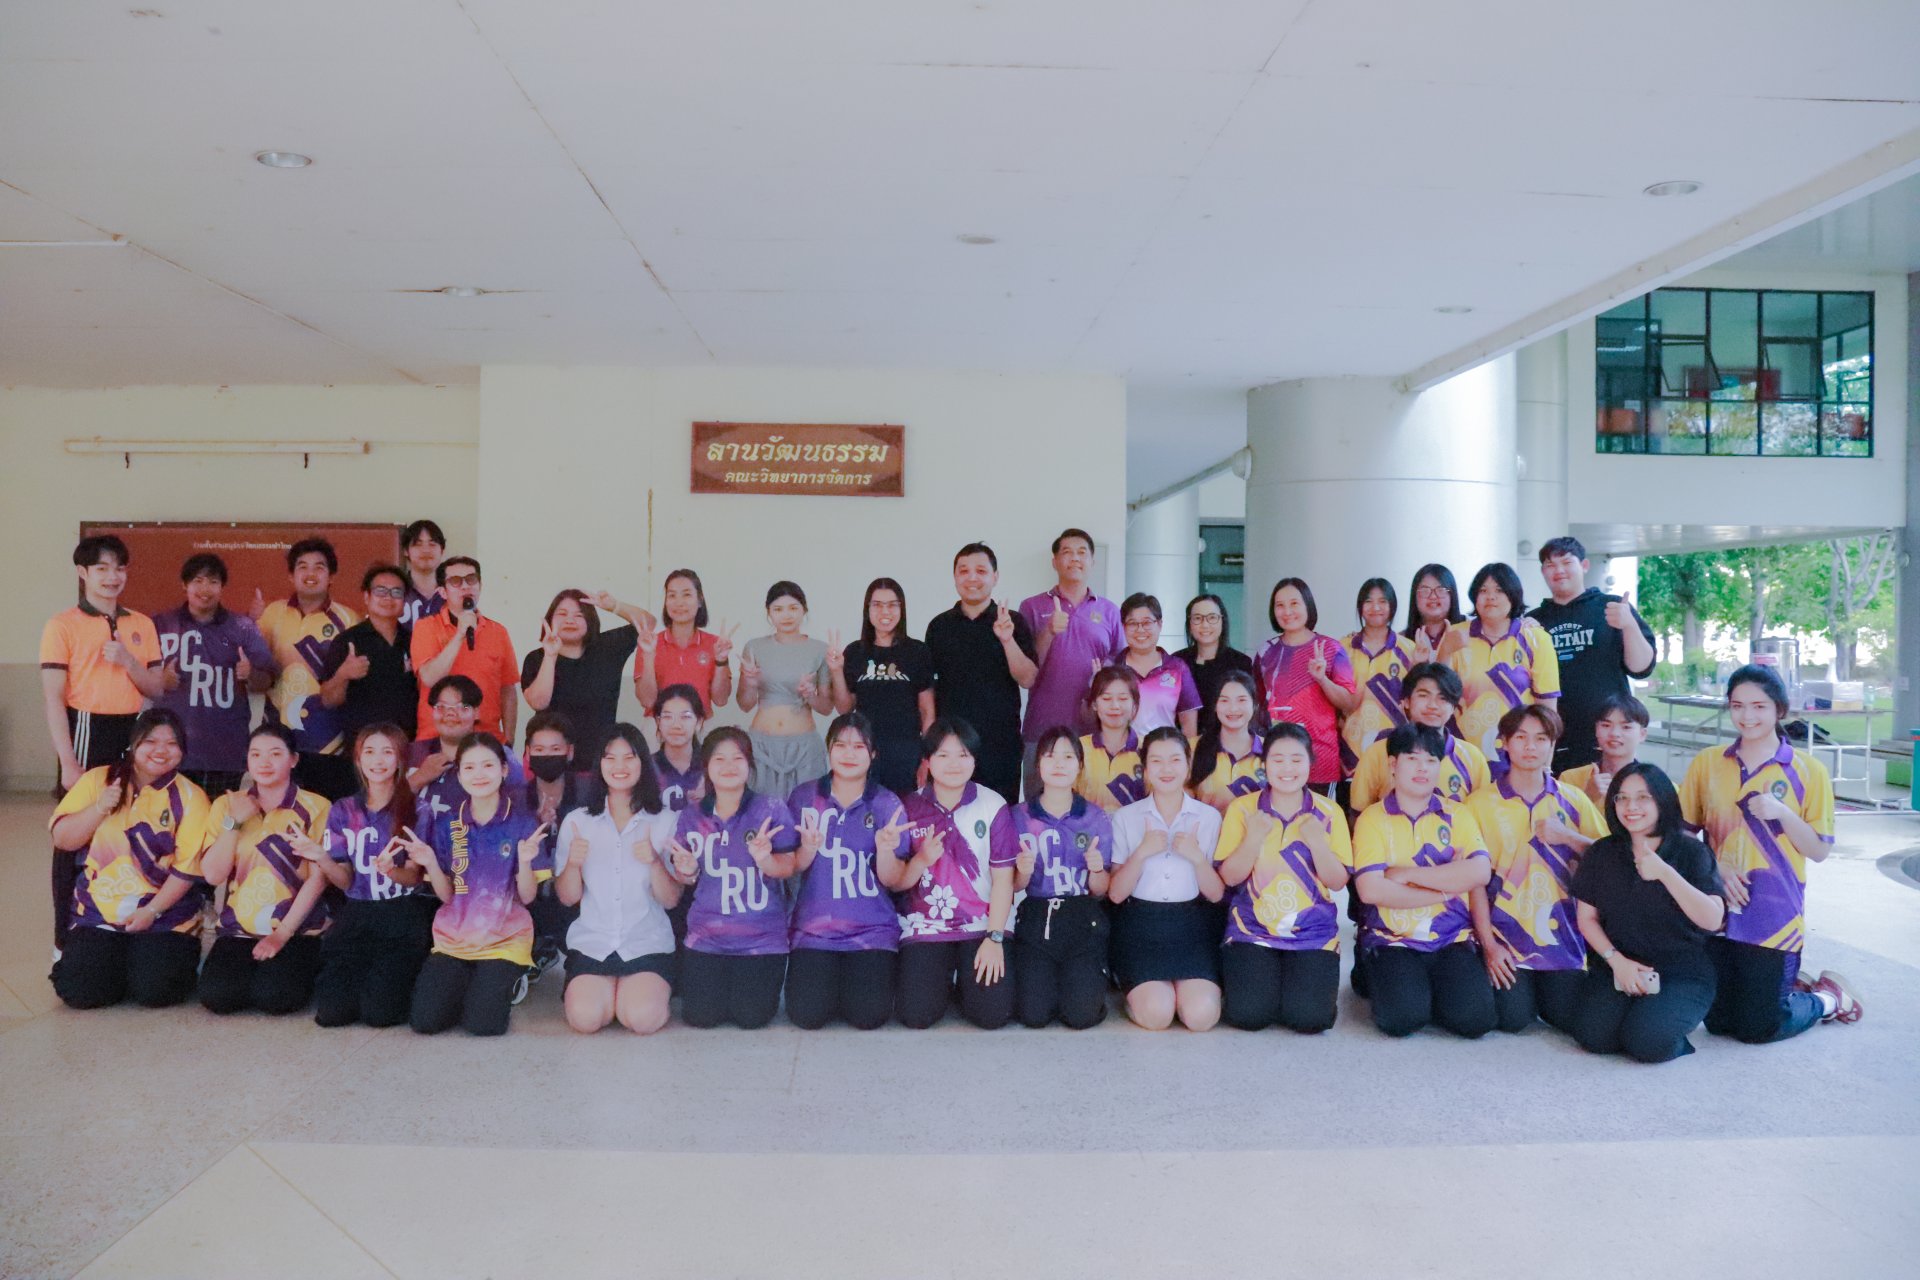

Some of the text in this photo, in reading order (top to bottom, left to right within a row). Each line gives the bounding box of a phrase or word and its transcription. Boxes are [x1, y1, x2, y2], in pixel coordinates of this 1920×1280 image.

[724, 468, 873, 485] คณะวิทยาการจัดการ
